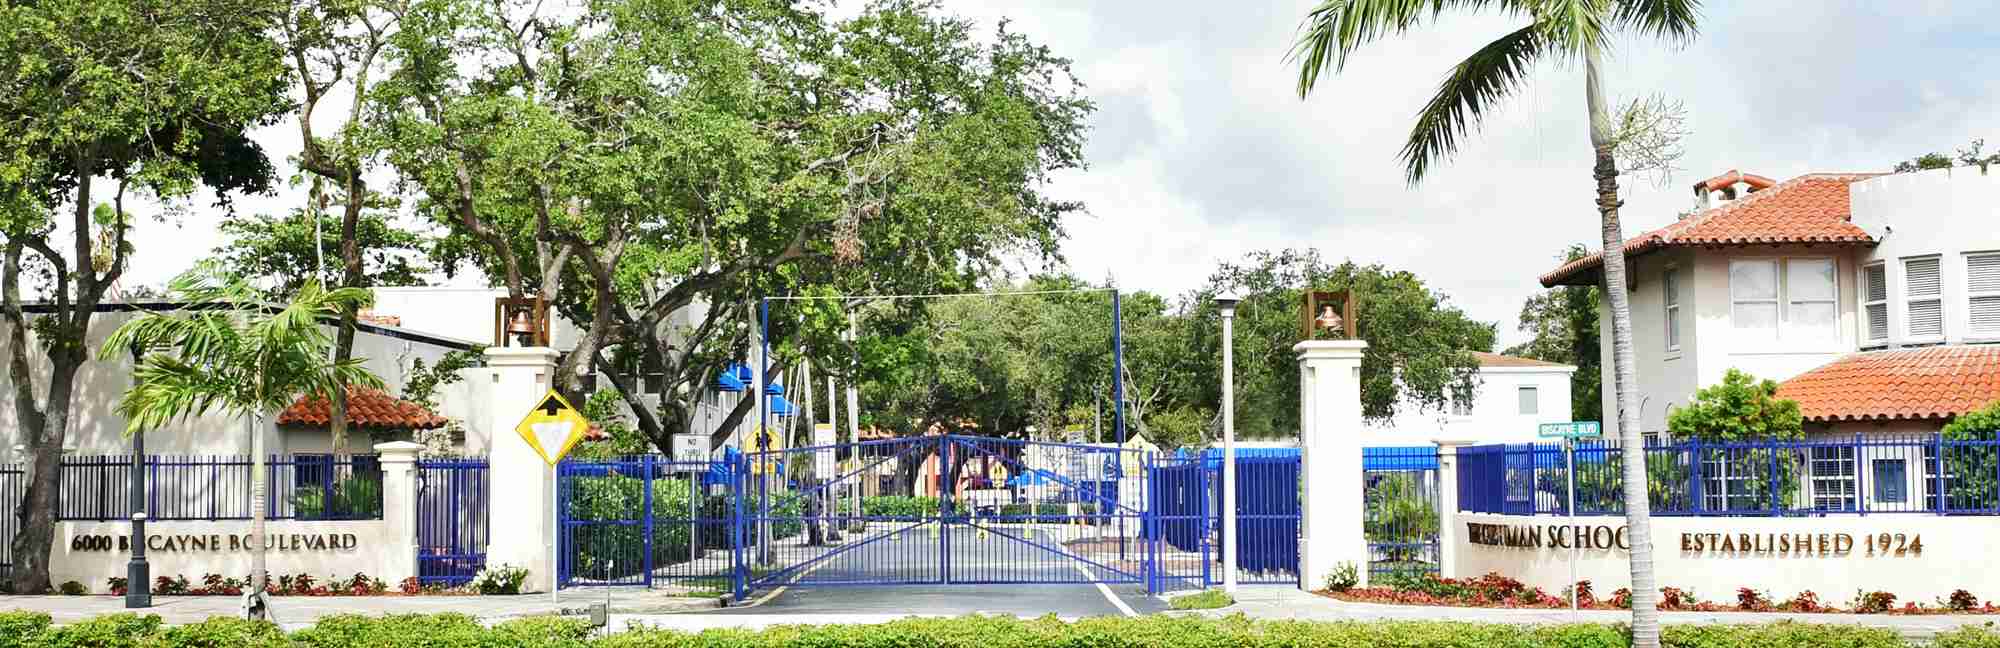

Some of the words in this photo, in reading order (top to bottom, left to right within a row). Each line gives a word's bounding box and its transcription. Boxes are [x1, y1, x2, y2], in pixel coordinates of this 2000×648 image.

[1578, 423, 1597, 433] BLVD
[71, 534, 113, 551] 6000
[1547, 525, 1653, 550] SCHOO
[1681, 532, 1854, 553] ESTABLISHED
[1864, 532, 1923, 554] 1924
